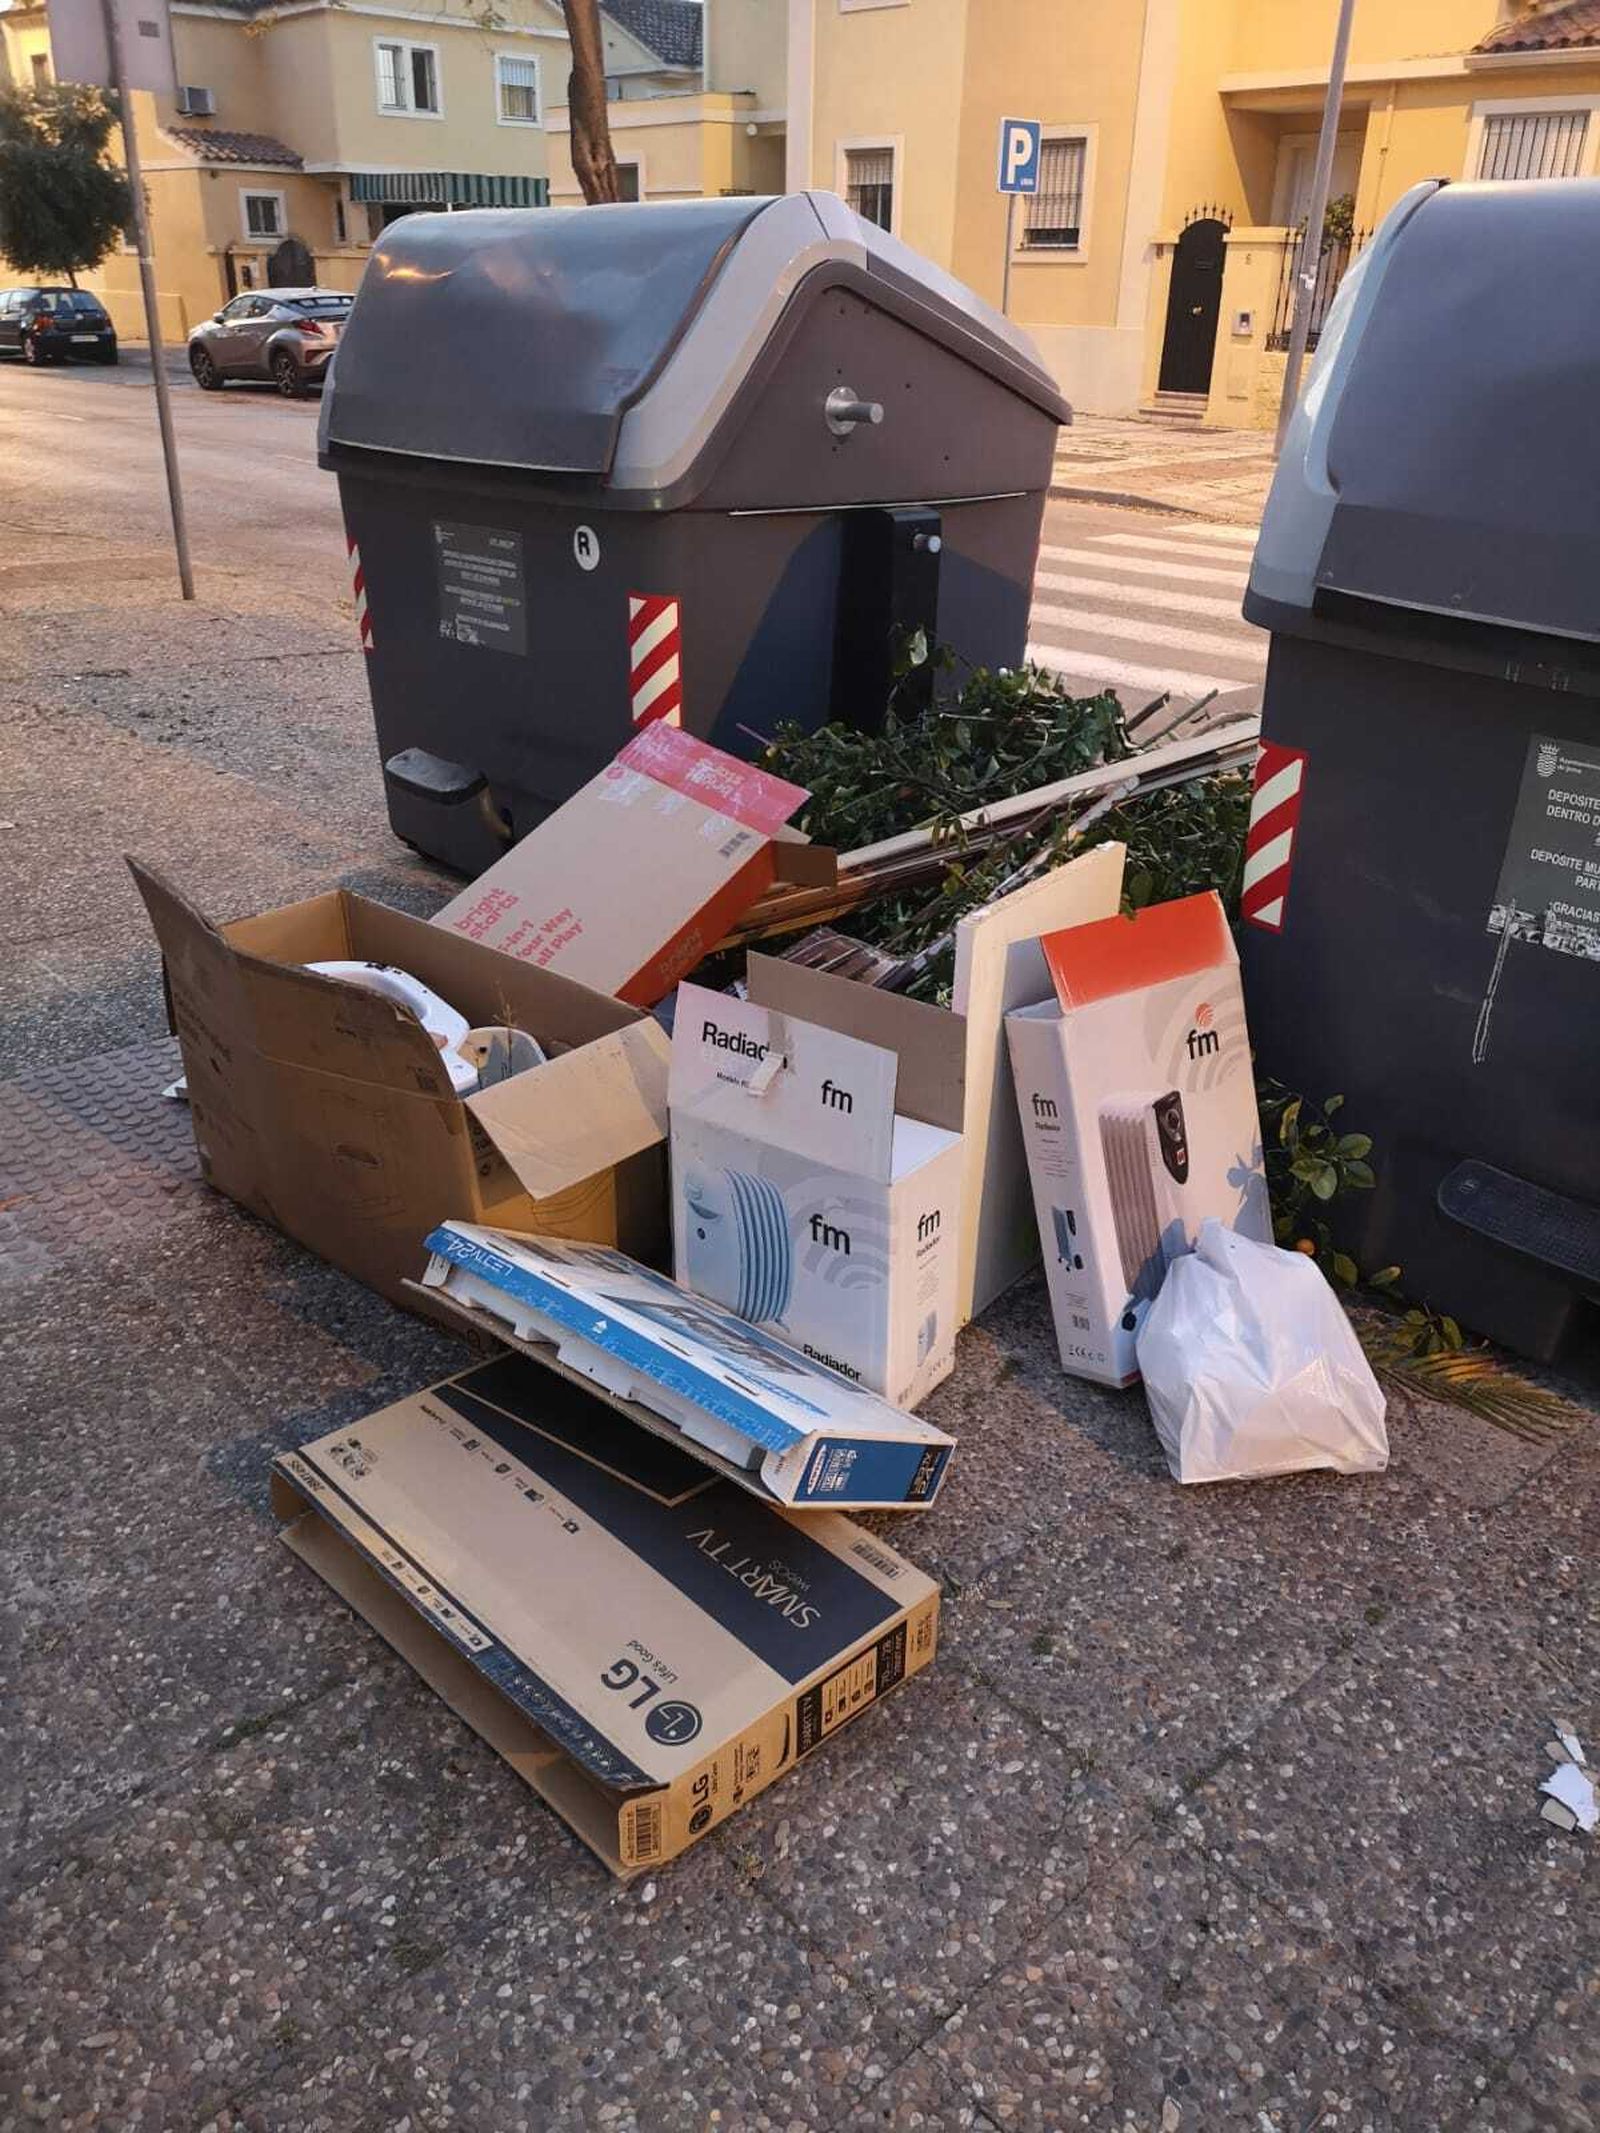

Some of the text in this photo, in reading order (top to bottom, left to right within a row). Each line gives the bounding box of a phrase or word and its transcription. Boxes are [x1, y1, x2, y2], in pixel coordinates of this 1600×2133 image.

[1007, 127, 1033, 184] P
[577, 531, 590, 556] R
[1546, 804, 1590, 824] DENTRO
[1548, 788, 1600, 810] DEPOSITE
[1531, 848, 1583, 871] DEPOSITE
[452, 887, 506, 930] bright
[469, 895, 519, 940] starts
[1185, 1028, 1220, 1060] fm
[820, 1079, 854, 1114] fm
[1032, 1092, 1058, 1118] fm
[809, 1213, 851, 1256] fm
[917, 1210, 941, 1243] fm
[803, 1343, 862, 1382] Radiador
[684, 1528, 822, 1629] SMART TV
[625, 1639, 679, 1685] Life's Good
[600, 1658, 662, 1710] LG
[692, 1773, 709, 1809] LG
